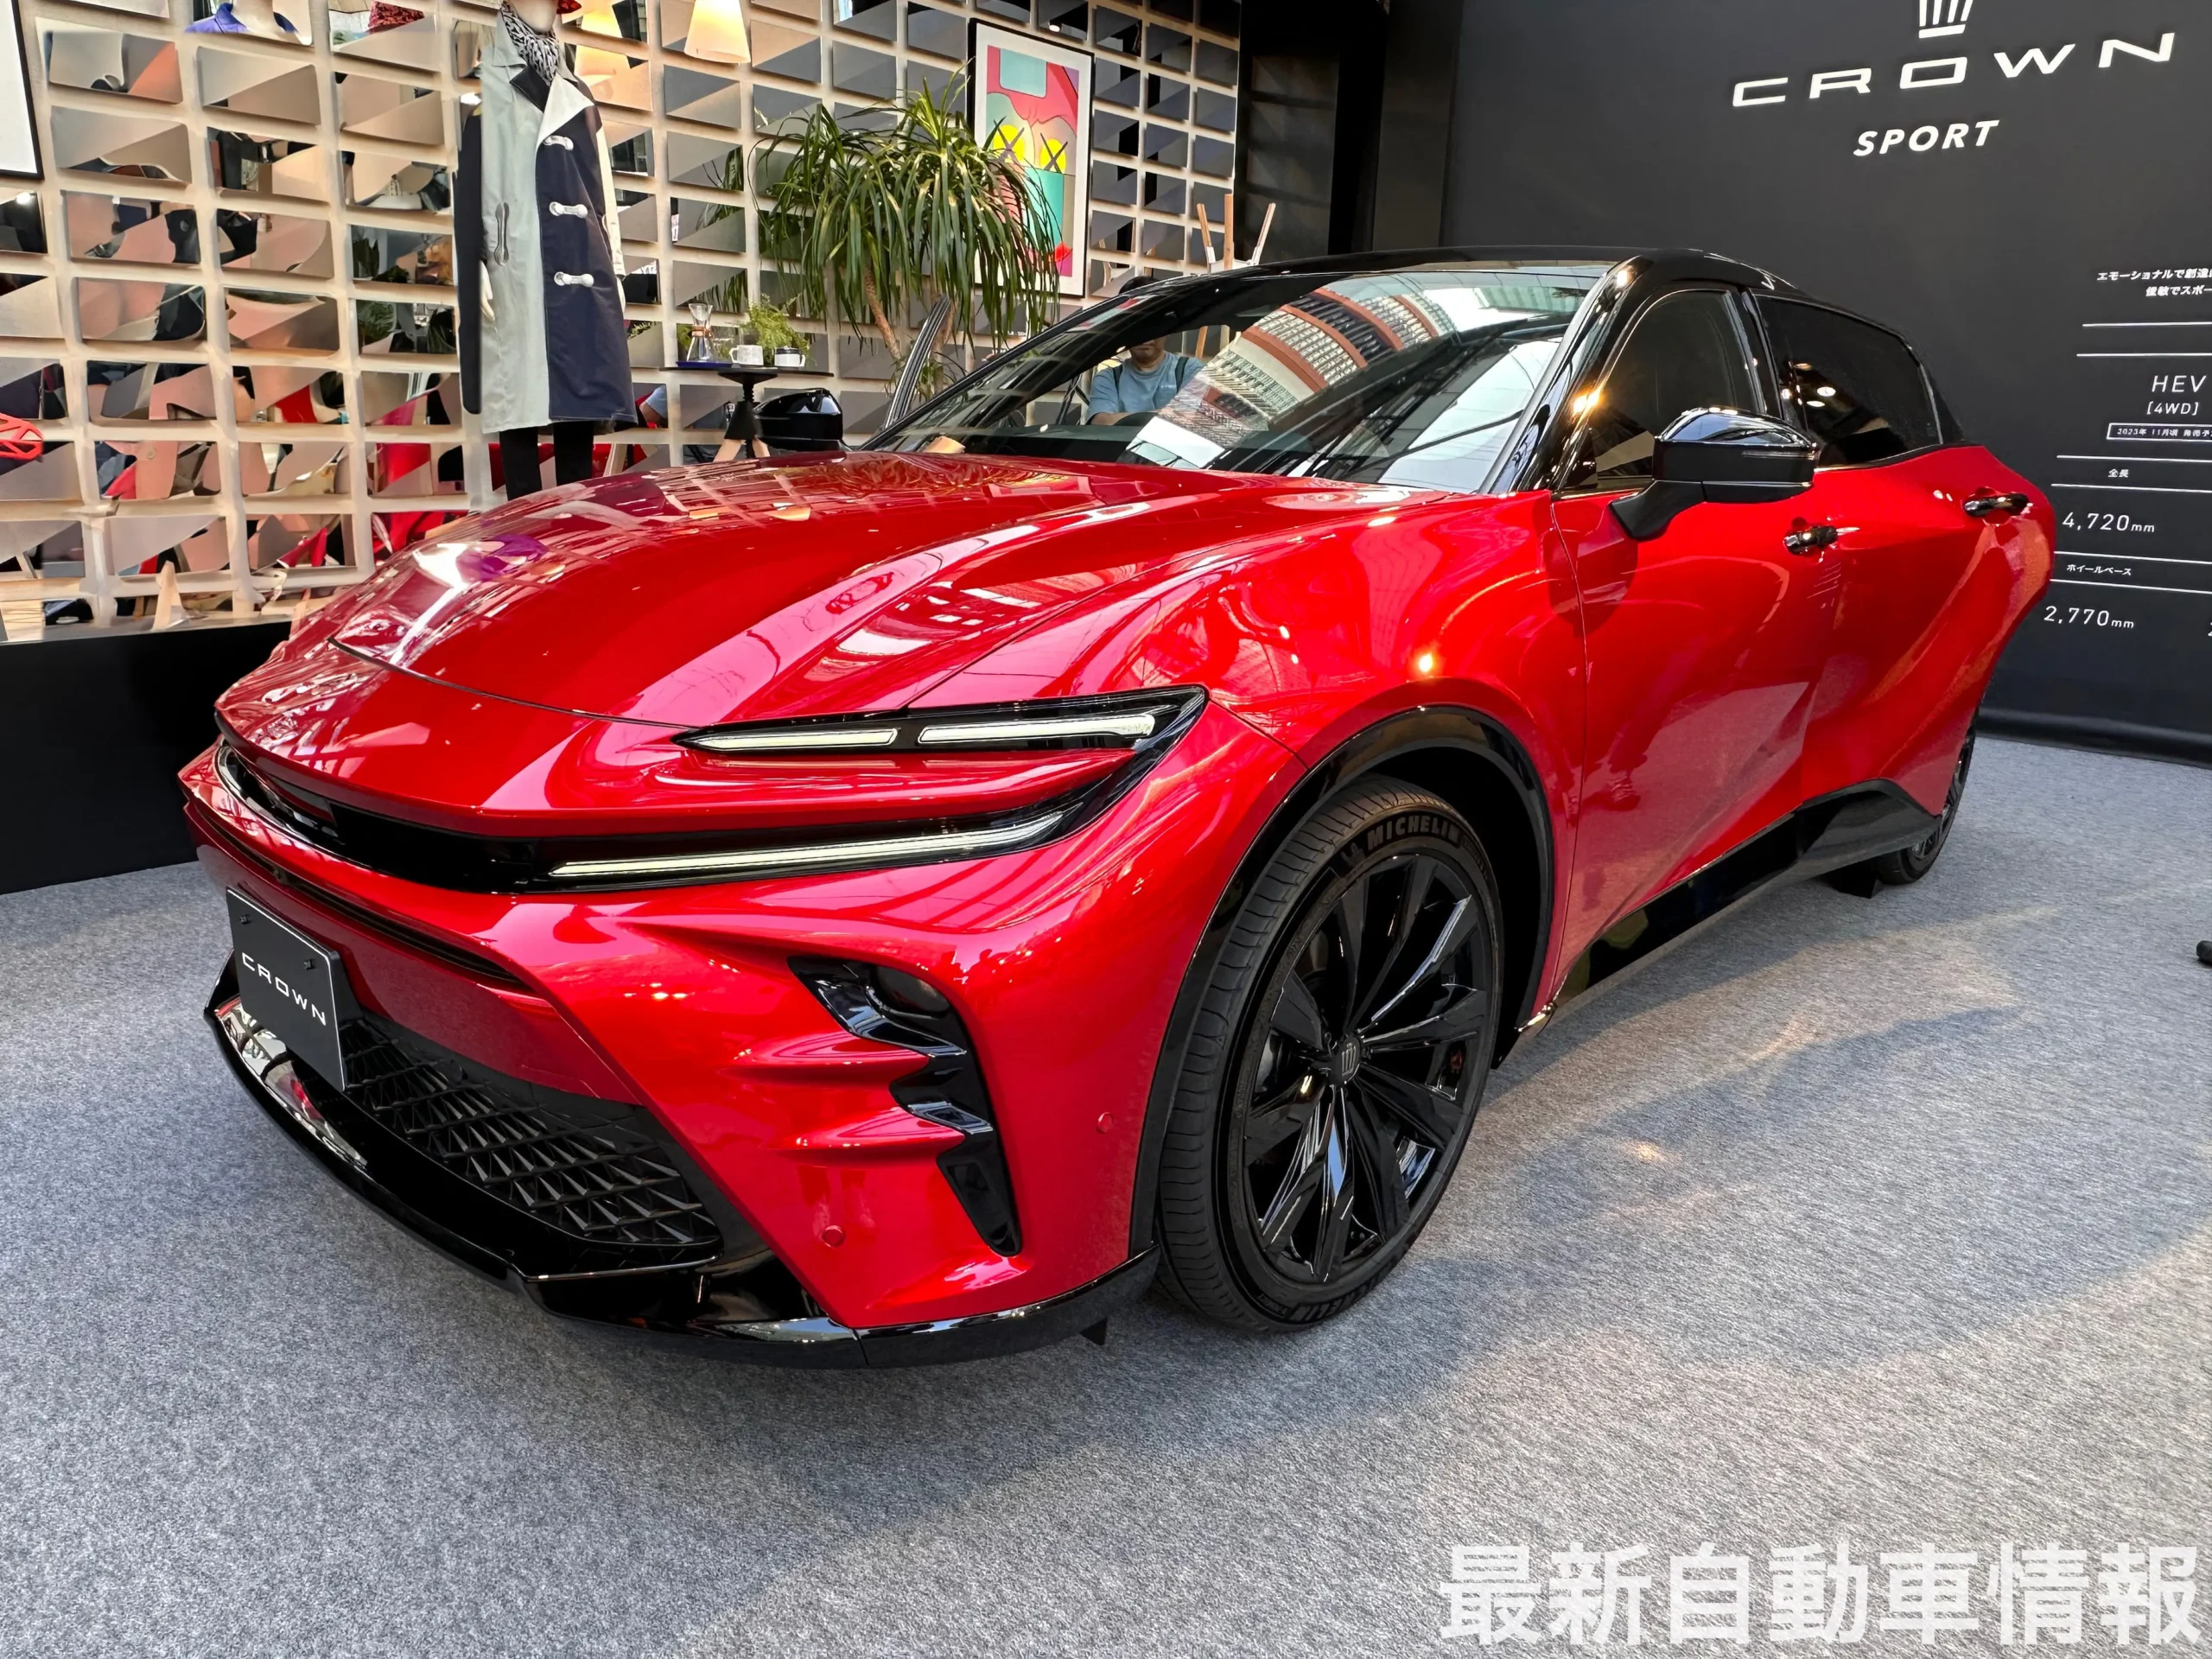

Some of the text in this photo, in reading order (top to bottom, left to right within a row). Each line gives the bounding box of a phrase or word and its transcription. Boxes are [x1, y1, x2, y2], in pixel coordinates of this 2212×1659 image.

[1732, 31, 2176, 108] CROWN
[1853, 119, 2000, 157] SPORT
[2096, 267, 2212, 282] エモーショナルで創造
[2152, 375, 2207, 393] HEV
[2183, 429, 2212, 437] 発売予
[2107, 468, 2129, 479] 全長
[2066, 563, 2132, 576] ホイールベース
[1367, 815, 1460, 851] MICHELIN
[241, 952, 327, 1027] CROWN
